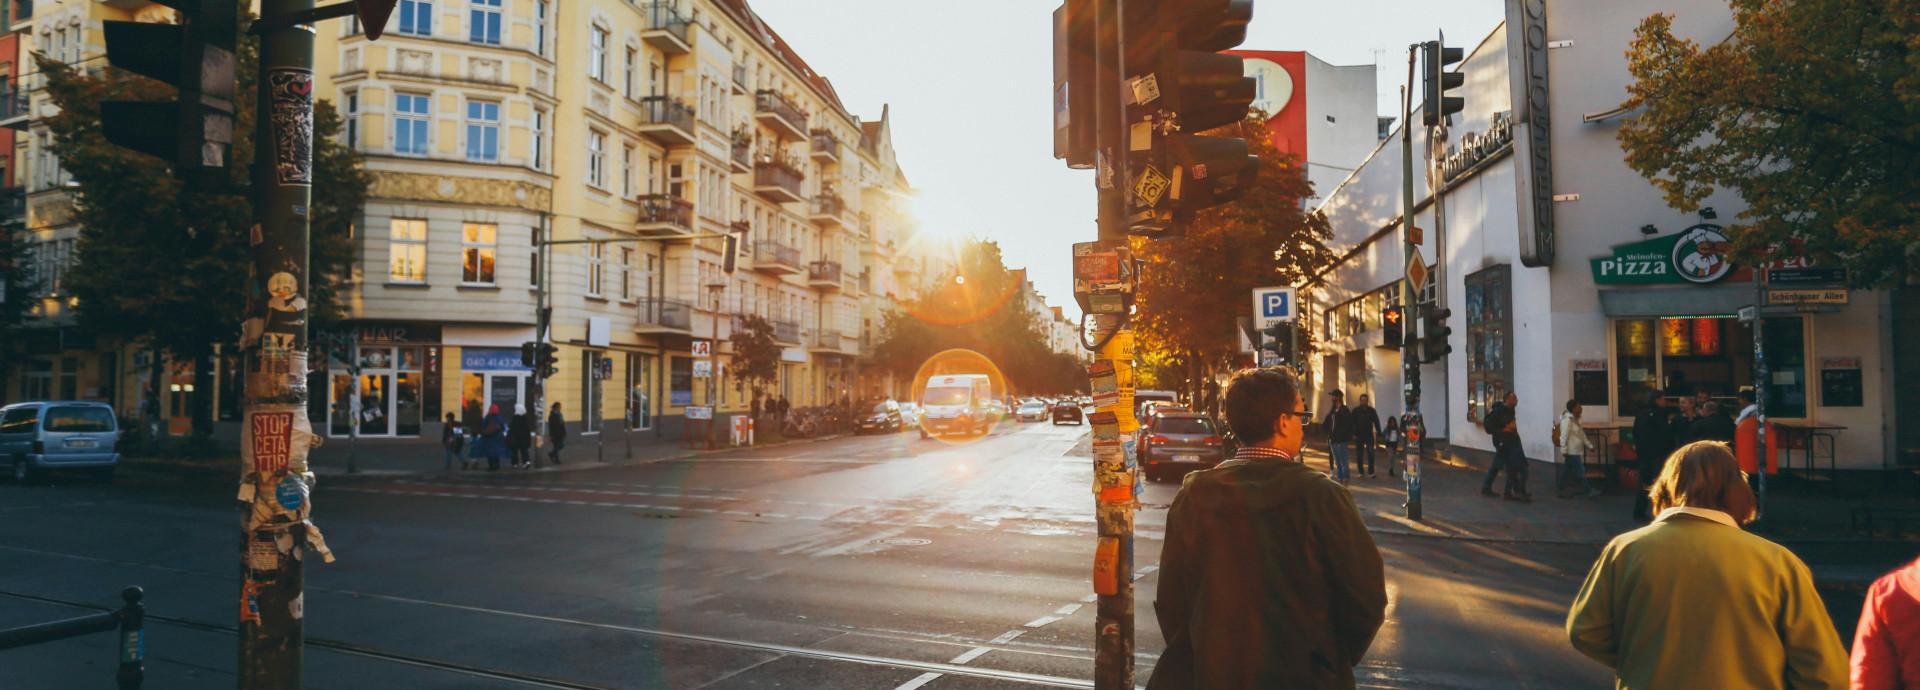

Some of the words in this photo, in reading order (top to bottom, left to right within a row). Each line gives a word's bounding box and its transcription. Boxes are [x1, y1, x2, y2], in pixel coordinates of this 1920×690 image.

[1525, 0, 1553, 254] COLOSSEUM
[1601, 257, 1667, 276] Pizza
[1268, 295, 1282, 314] P
[1824, 292, 1844, 300] Allee
[254, 414, 289, 435] STOP
[255, 436, 287, 454] CETA
[256, 454, 287, 471] TTIP
